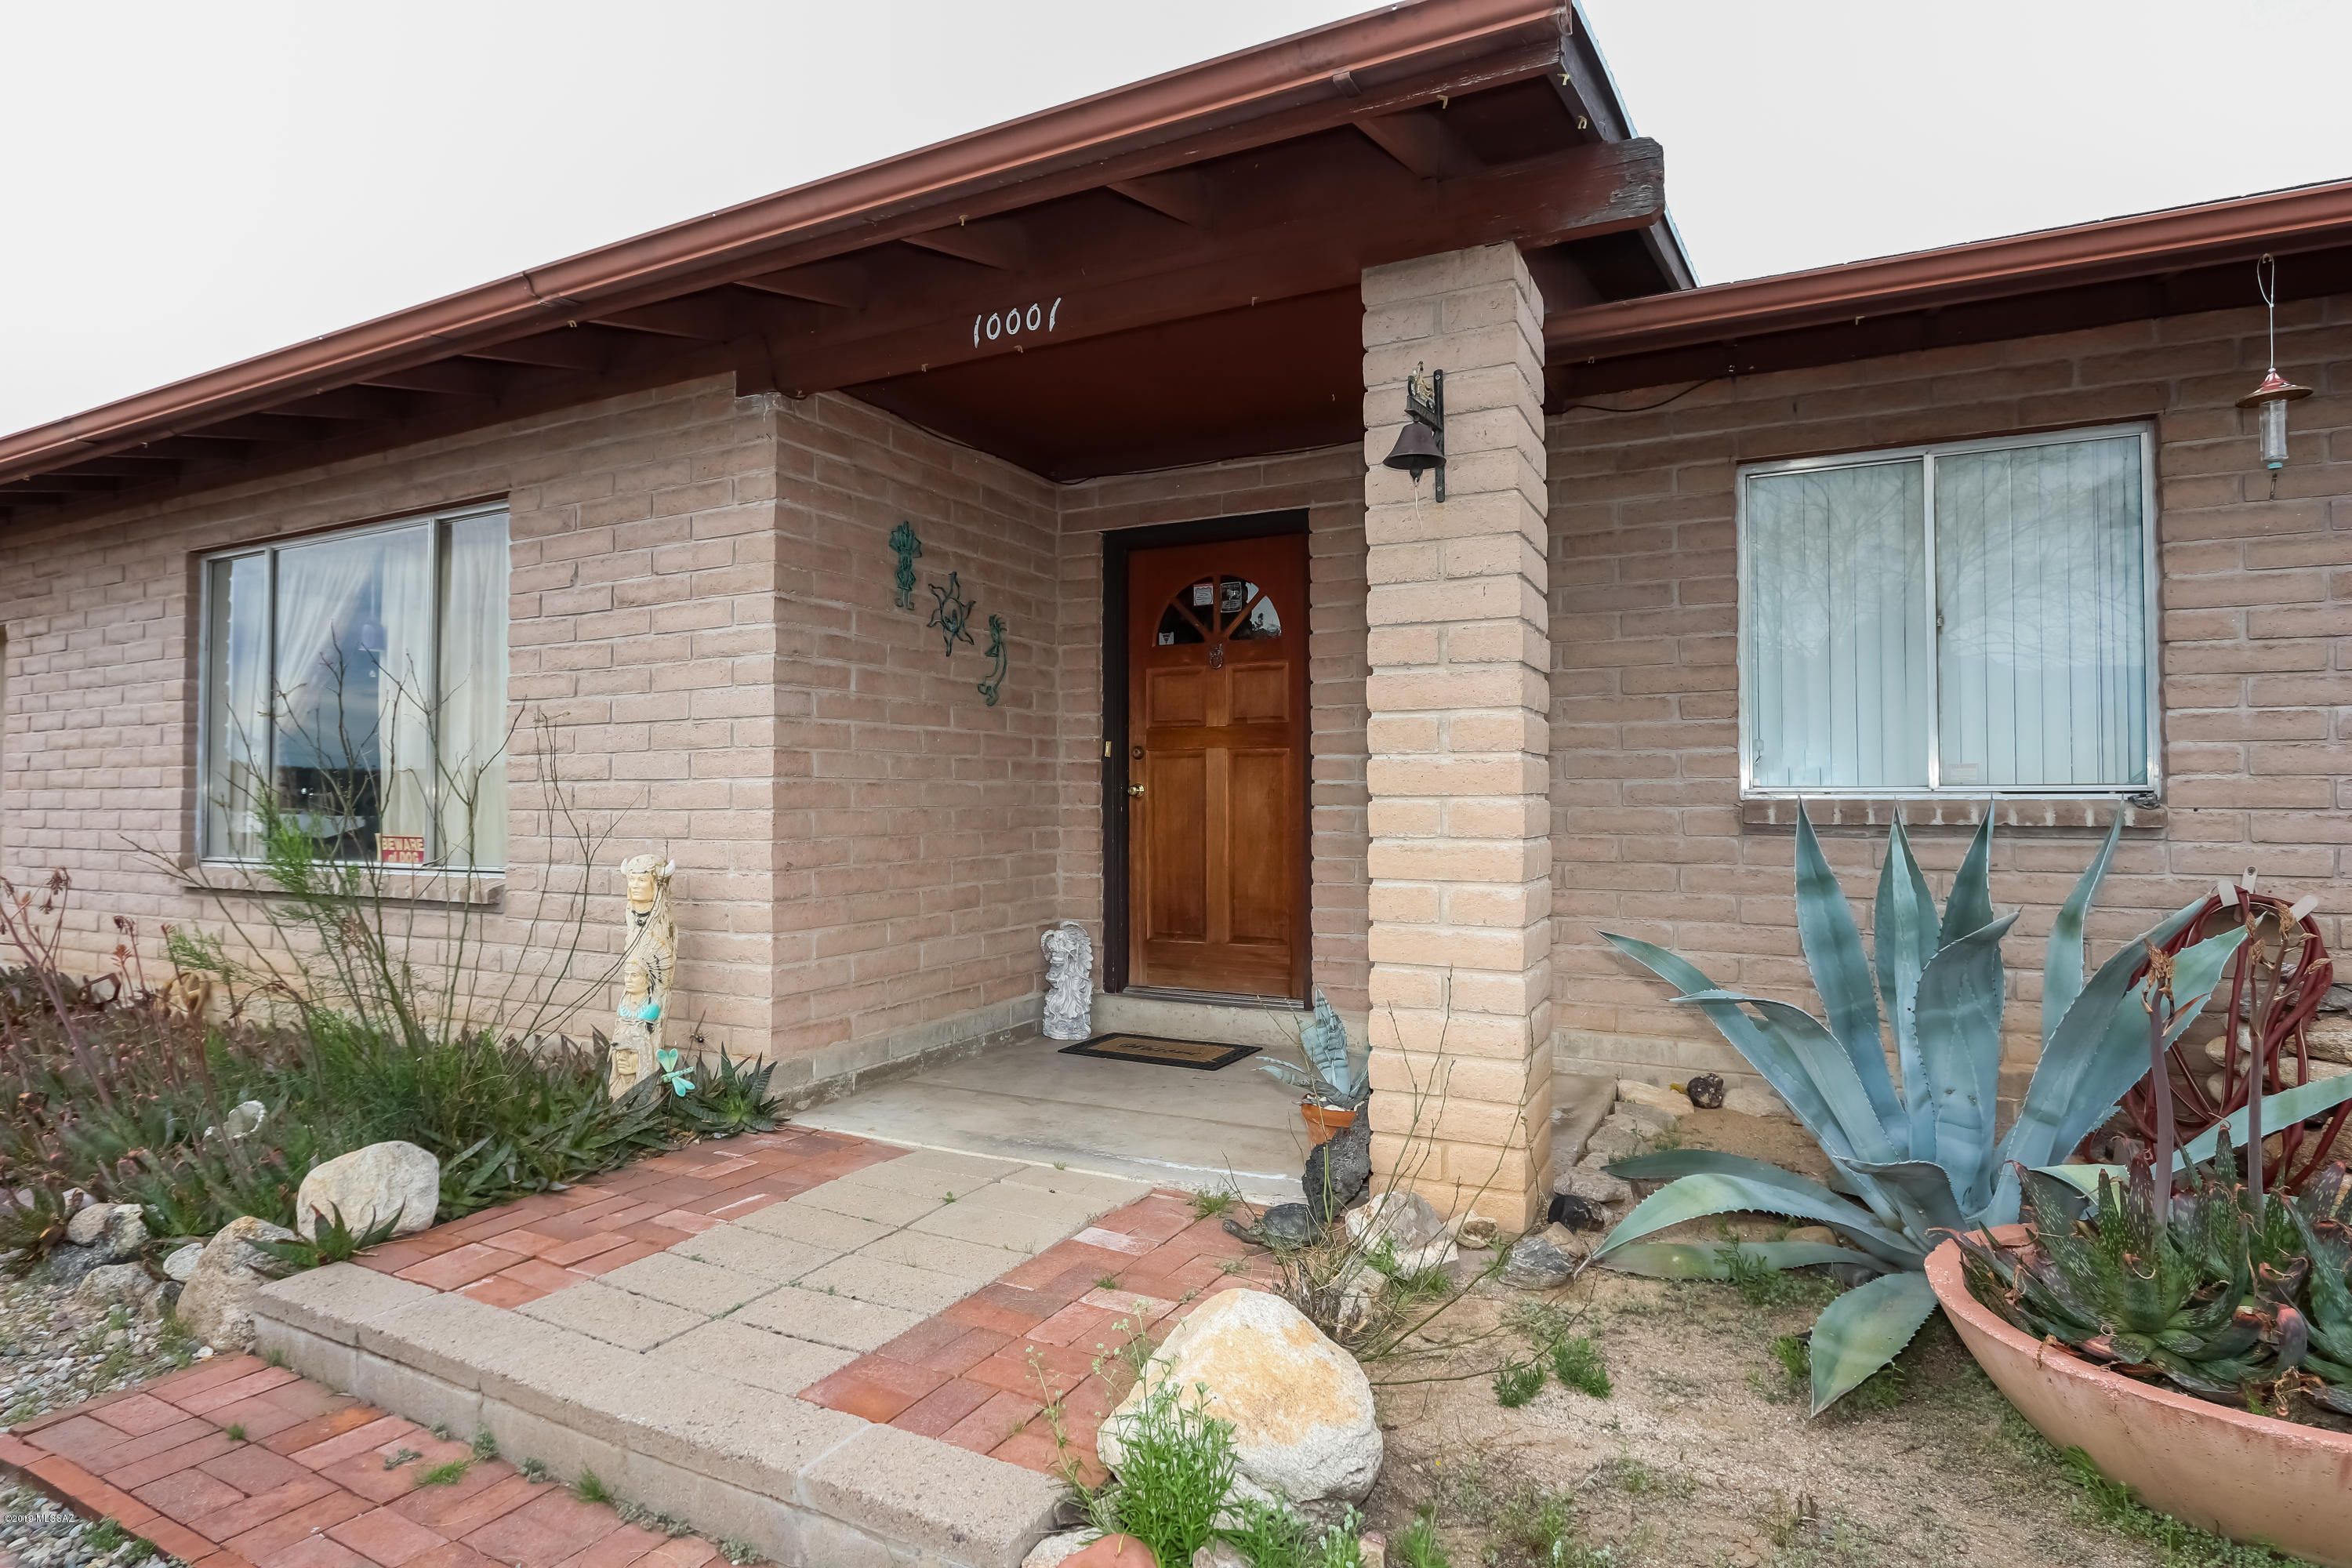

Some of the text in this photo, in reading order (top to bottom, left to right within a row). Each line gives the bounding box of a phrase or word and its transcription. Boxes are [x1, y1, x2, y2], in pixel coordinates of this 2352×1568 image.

[974, 297, 1062, 349] 10001
[382, 837, 424, 851] BEWARE
[399, 851, 419, 862] DOG
